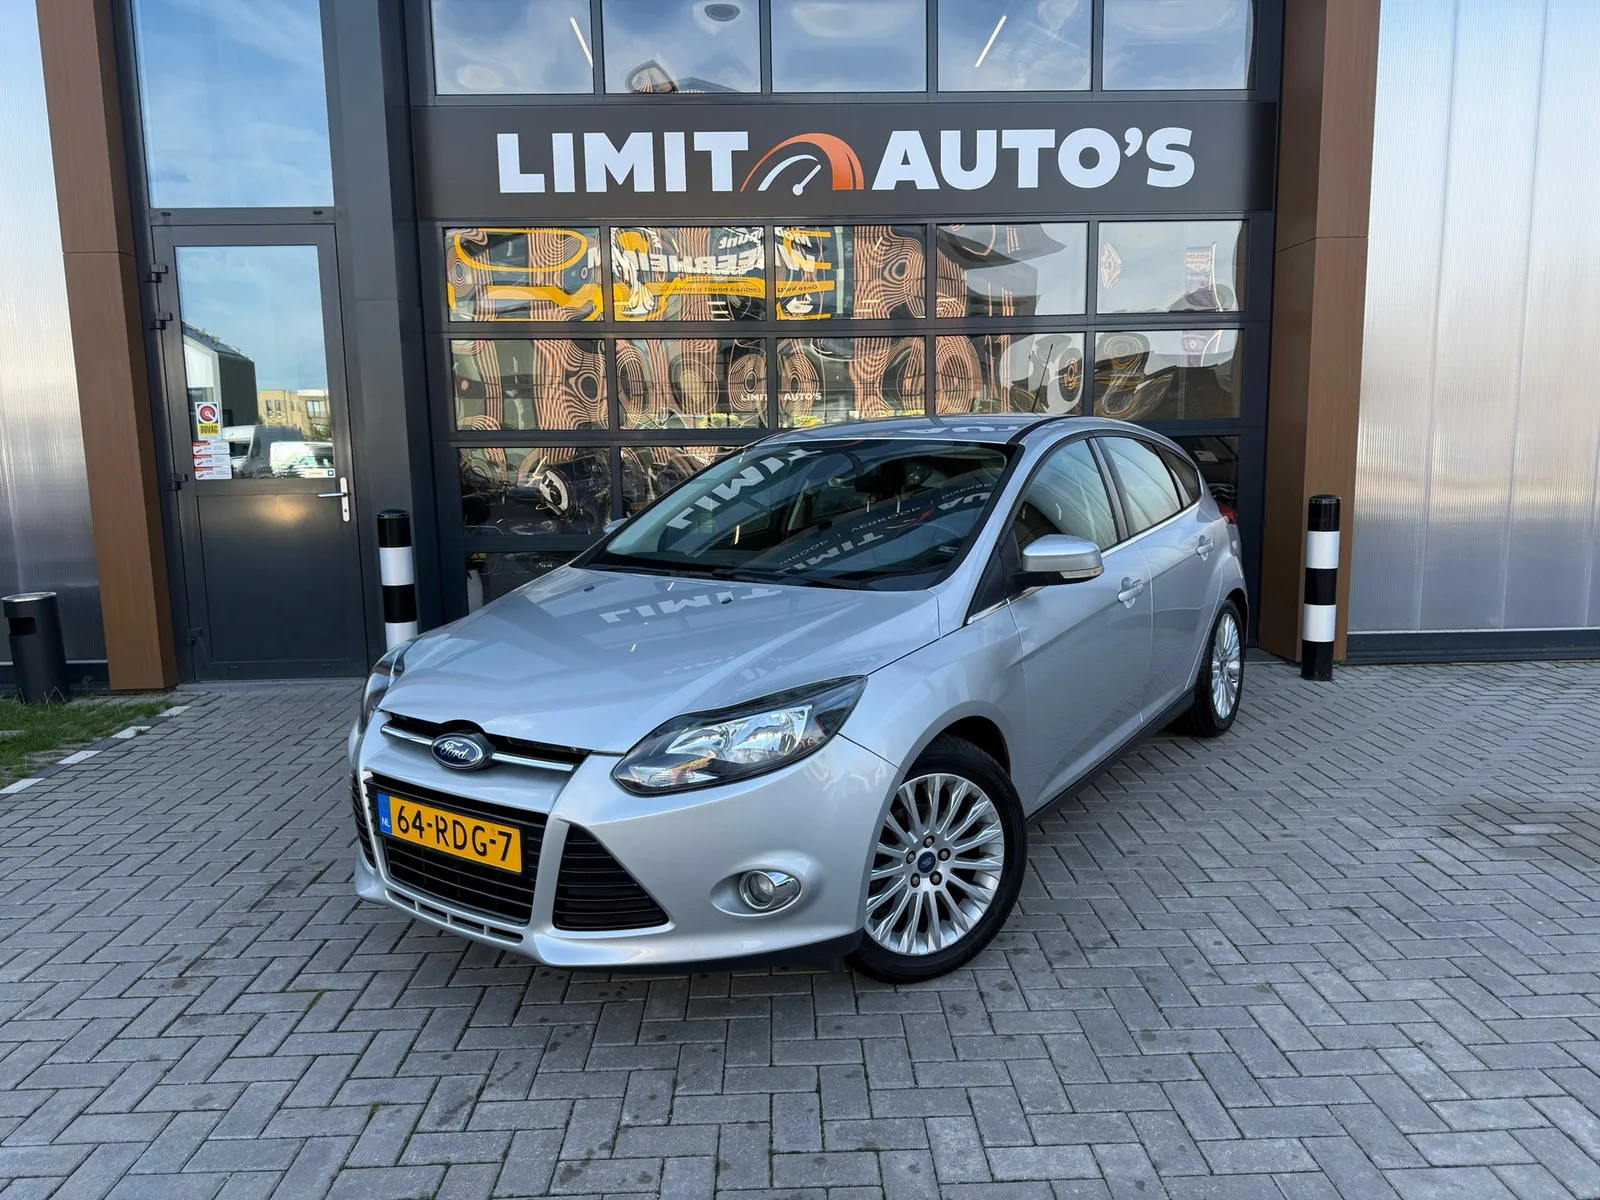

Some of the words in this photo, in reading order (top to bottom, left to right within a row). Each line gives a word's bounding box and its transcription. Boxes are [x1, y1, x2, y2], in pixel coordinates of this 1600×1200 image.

[497, 131, 749, 194] LIMIT
[872, 127, 1196, 191] AUTO'S
[200, 424, 219, 435] BOVAG
[439, 740, 468, 760] Ford
[381, 816, 391, 828] NL
[397, 804, 513, 862] 64-RDG-7
